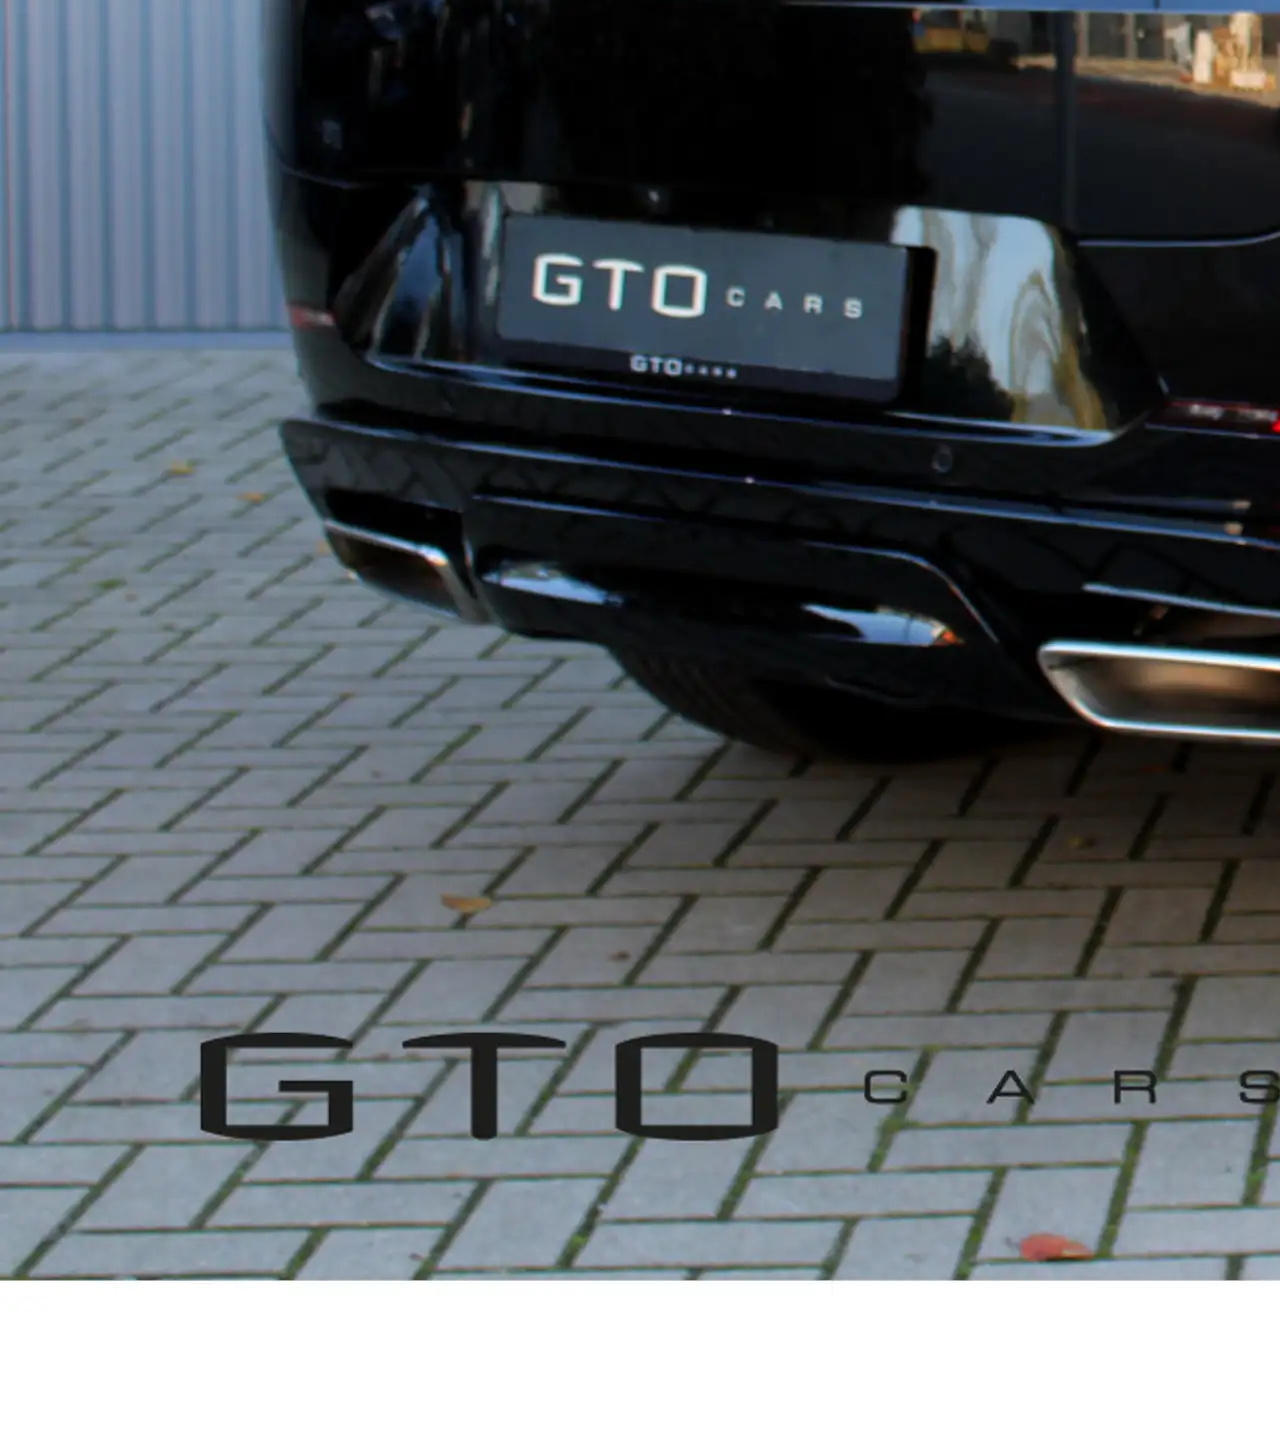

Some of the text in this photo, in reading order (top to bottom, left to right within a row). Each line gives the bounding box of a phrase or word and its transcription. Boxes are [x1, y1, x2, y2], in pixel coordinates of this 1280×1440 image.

[532, 253, 864, 319] GTO CARS
[630, 354, 683, 376] GTO
